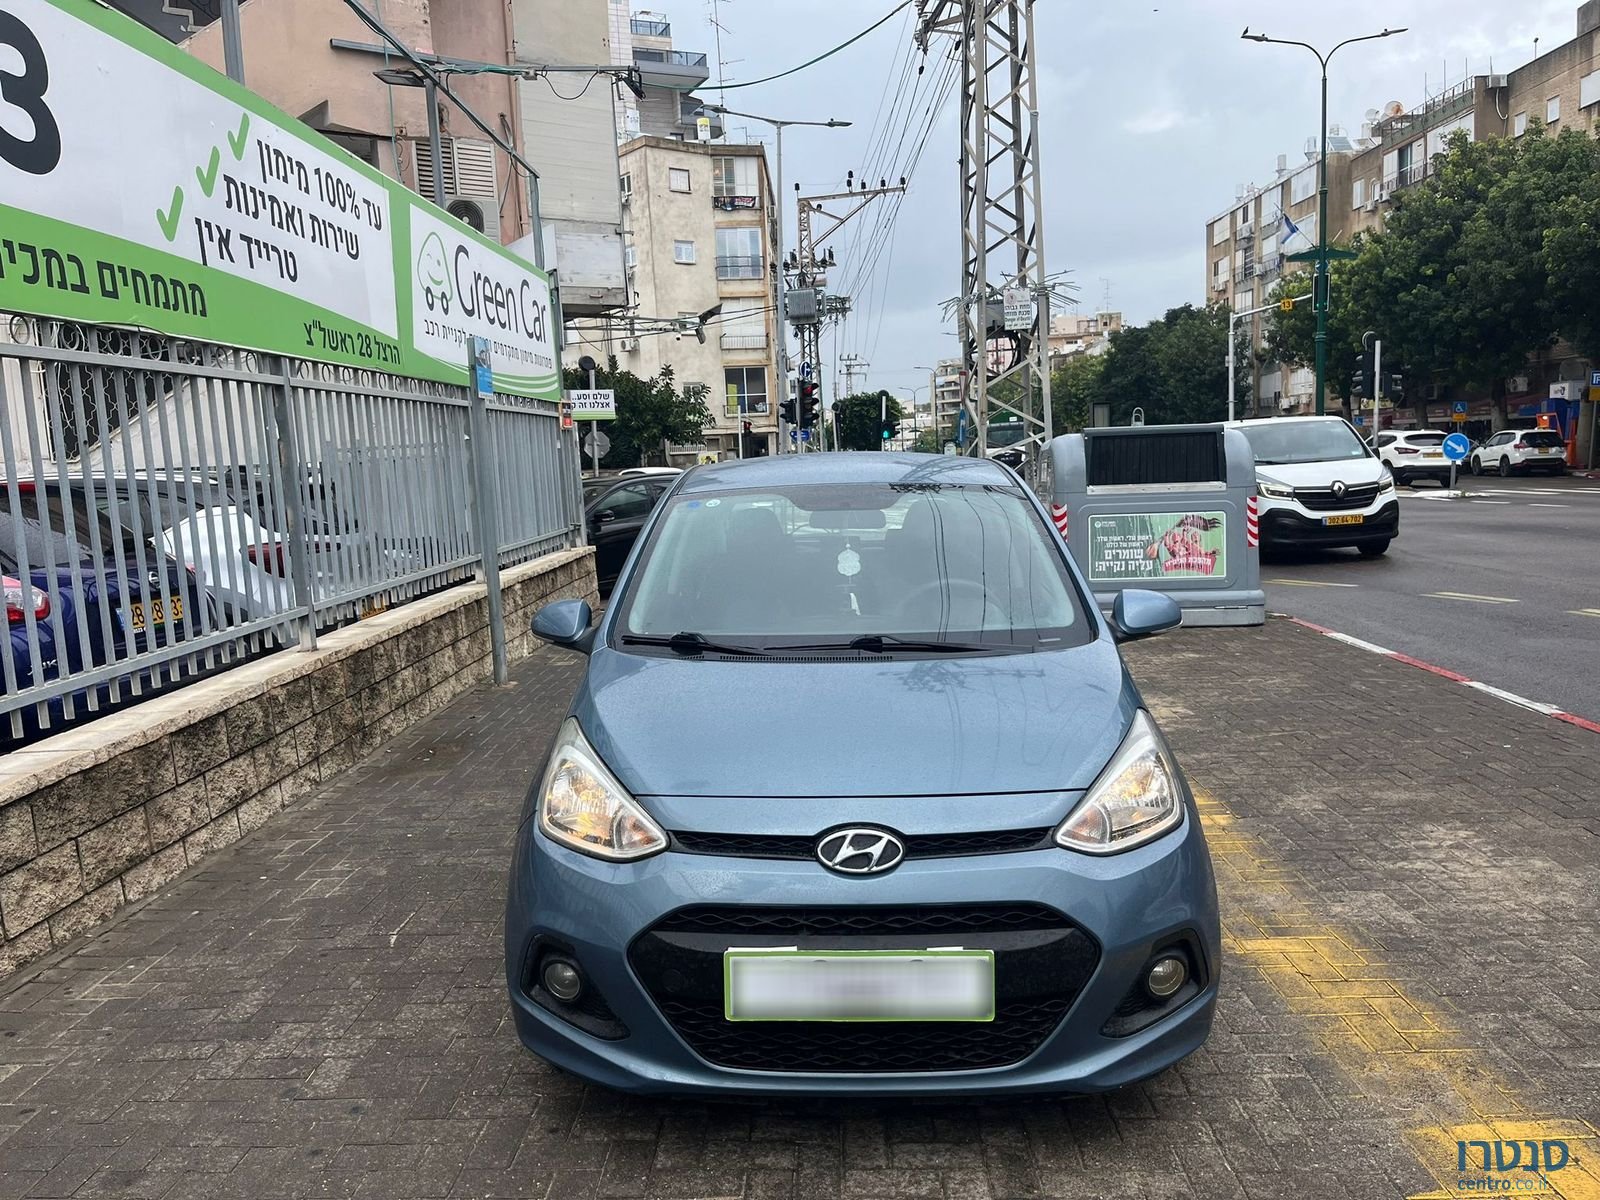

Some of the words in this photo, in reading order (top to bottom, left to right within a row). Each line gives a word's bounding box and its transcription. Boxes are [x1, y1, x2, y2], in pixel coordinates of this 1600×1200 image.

[256, 138, 310, 195] מימון
[223, 174, 306, 239] ואמינות
[314, 167, 361, 220] 100%
[362, 197, 382, 231] עד
[194, 216, 236, 266] אין
[309, 212, 360, 260] שירות
[0, 238, 90, 294] במכי
[239, 232, 298, 283] טרייד
[96, 260, 208, 318] מתמחים
[454, 244, 518, 334] Green
[520, 278, 547, 344] Car
[1282, 300, 1291, 309] 13
[356, 332, 372, 358] 28
[424, 320, 440, 338] רכב
[442, 325, 466, 348] לקניית
[374, 335, 400, 365] הרצל
[592, 392, 610, 400] שלם
[1095, 560, 1126, 573] נקייה!
[1104, 548, 1143, 560] שומרים
[1128, 559, 1153, 571] עליה
